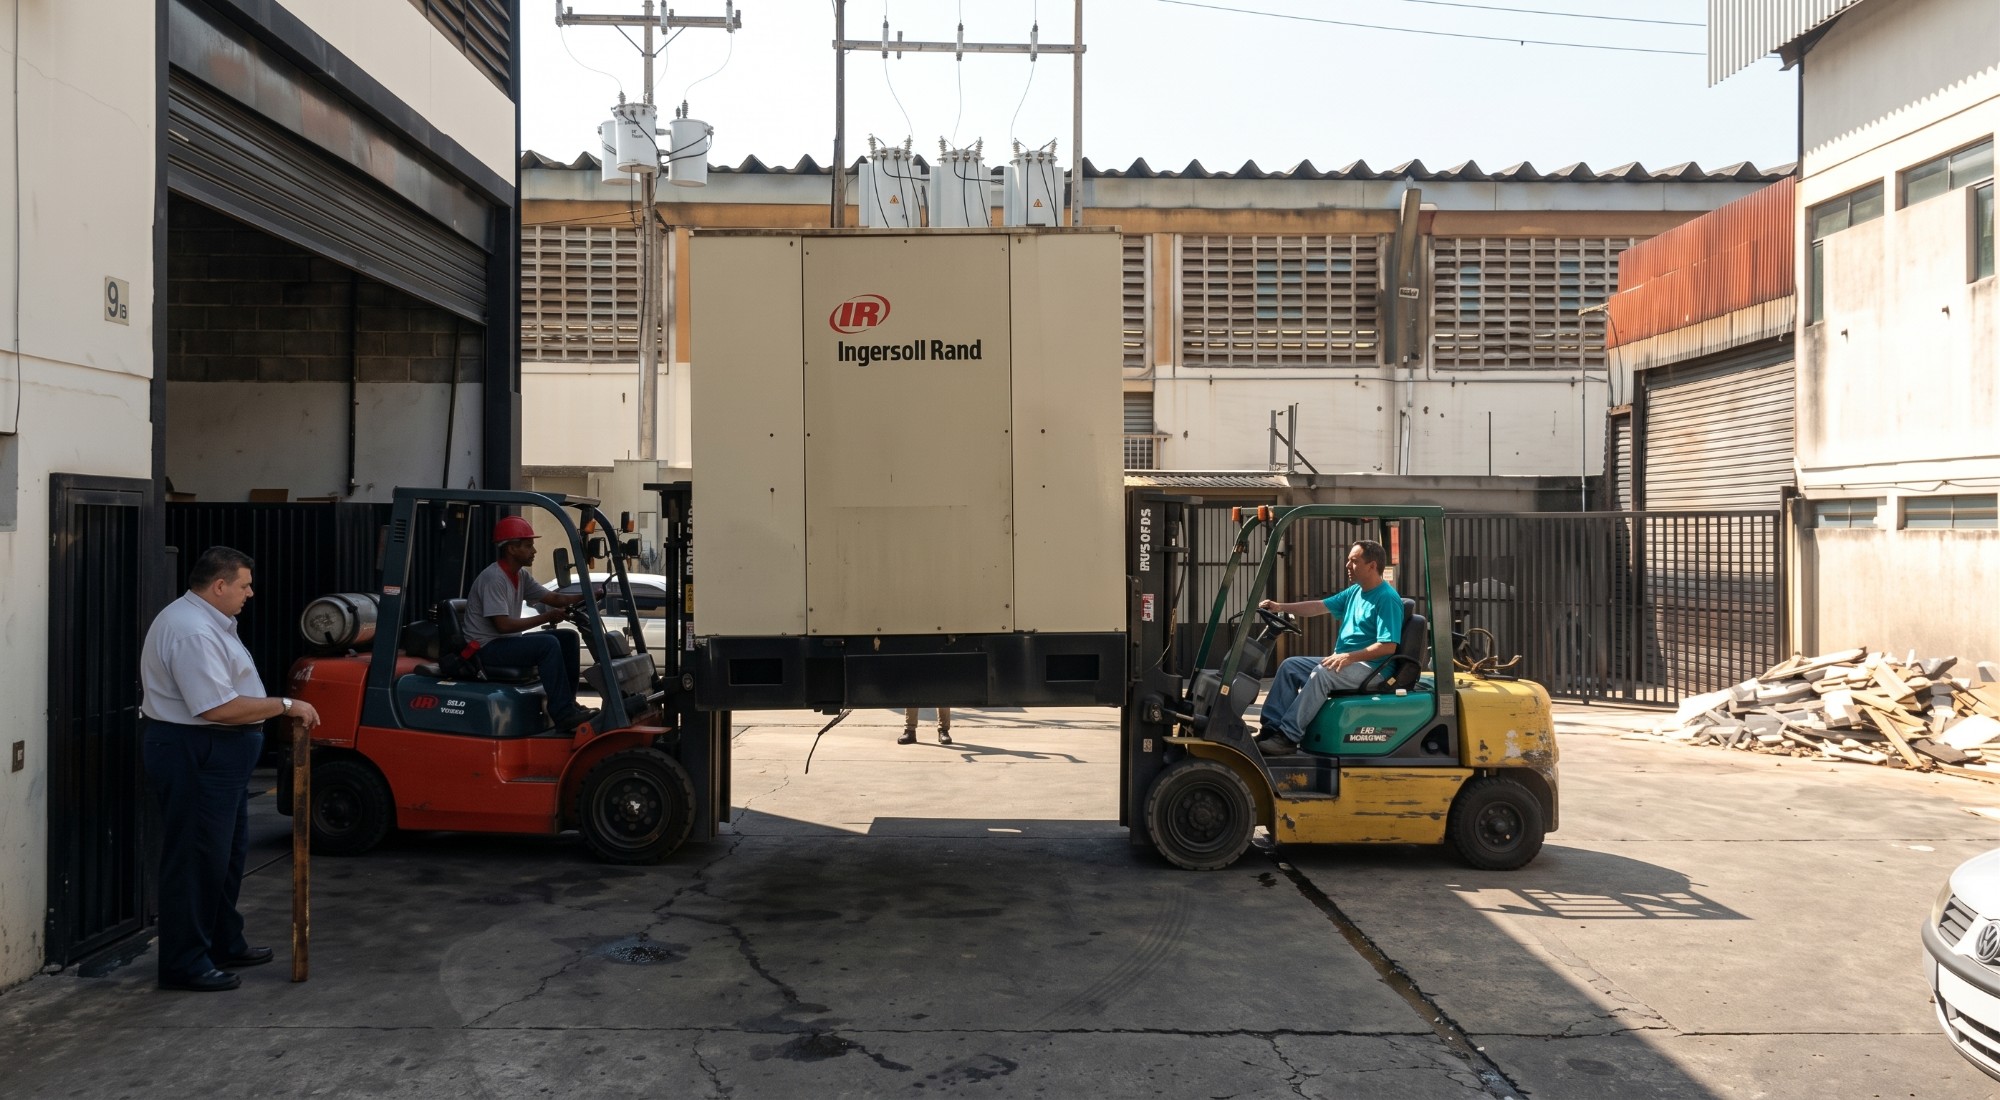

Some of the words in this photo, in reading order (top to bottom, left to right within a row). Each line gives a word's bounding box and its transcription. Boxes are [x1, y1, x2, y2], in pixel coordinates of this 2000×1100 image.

[838, 301, 881, 327] IR
[838, 340, 926, 367] Ingersoll
[930, 339, 982, 361] Rand
